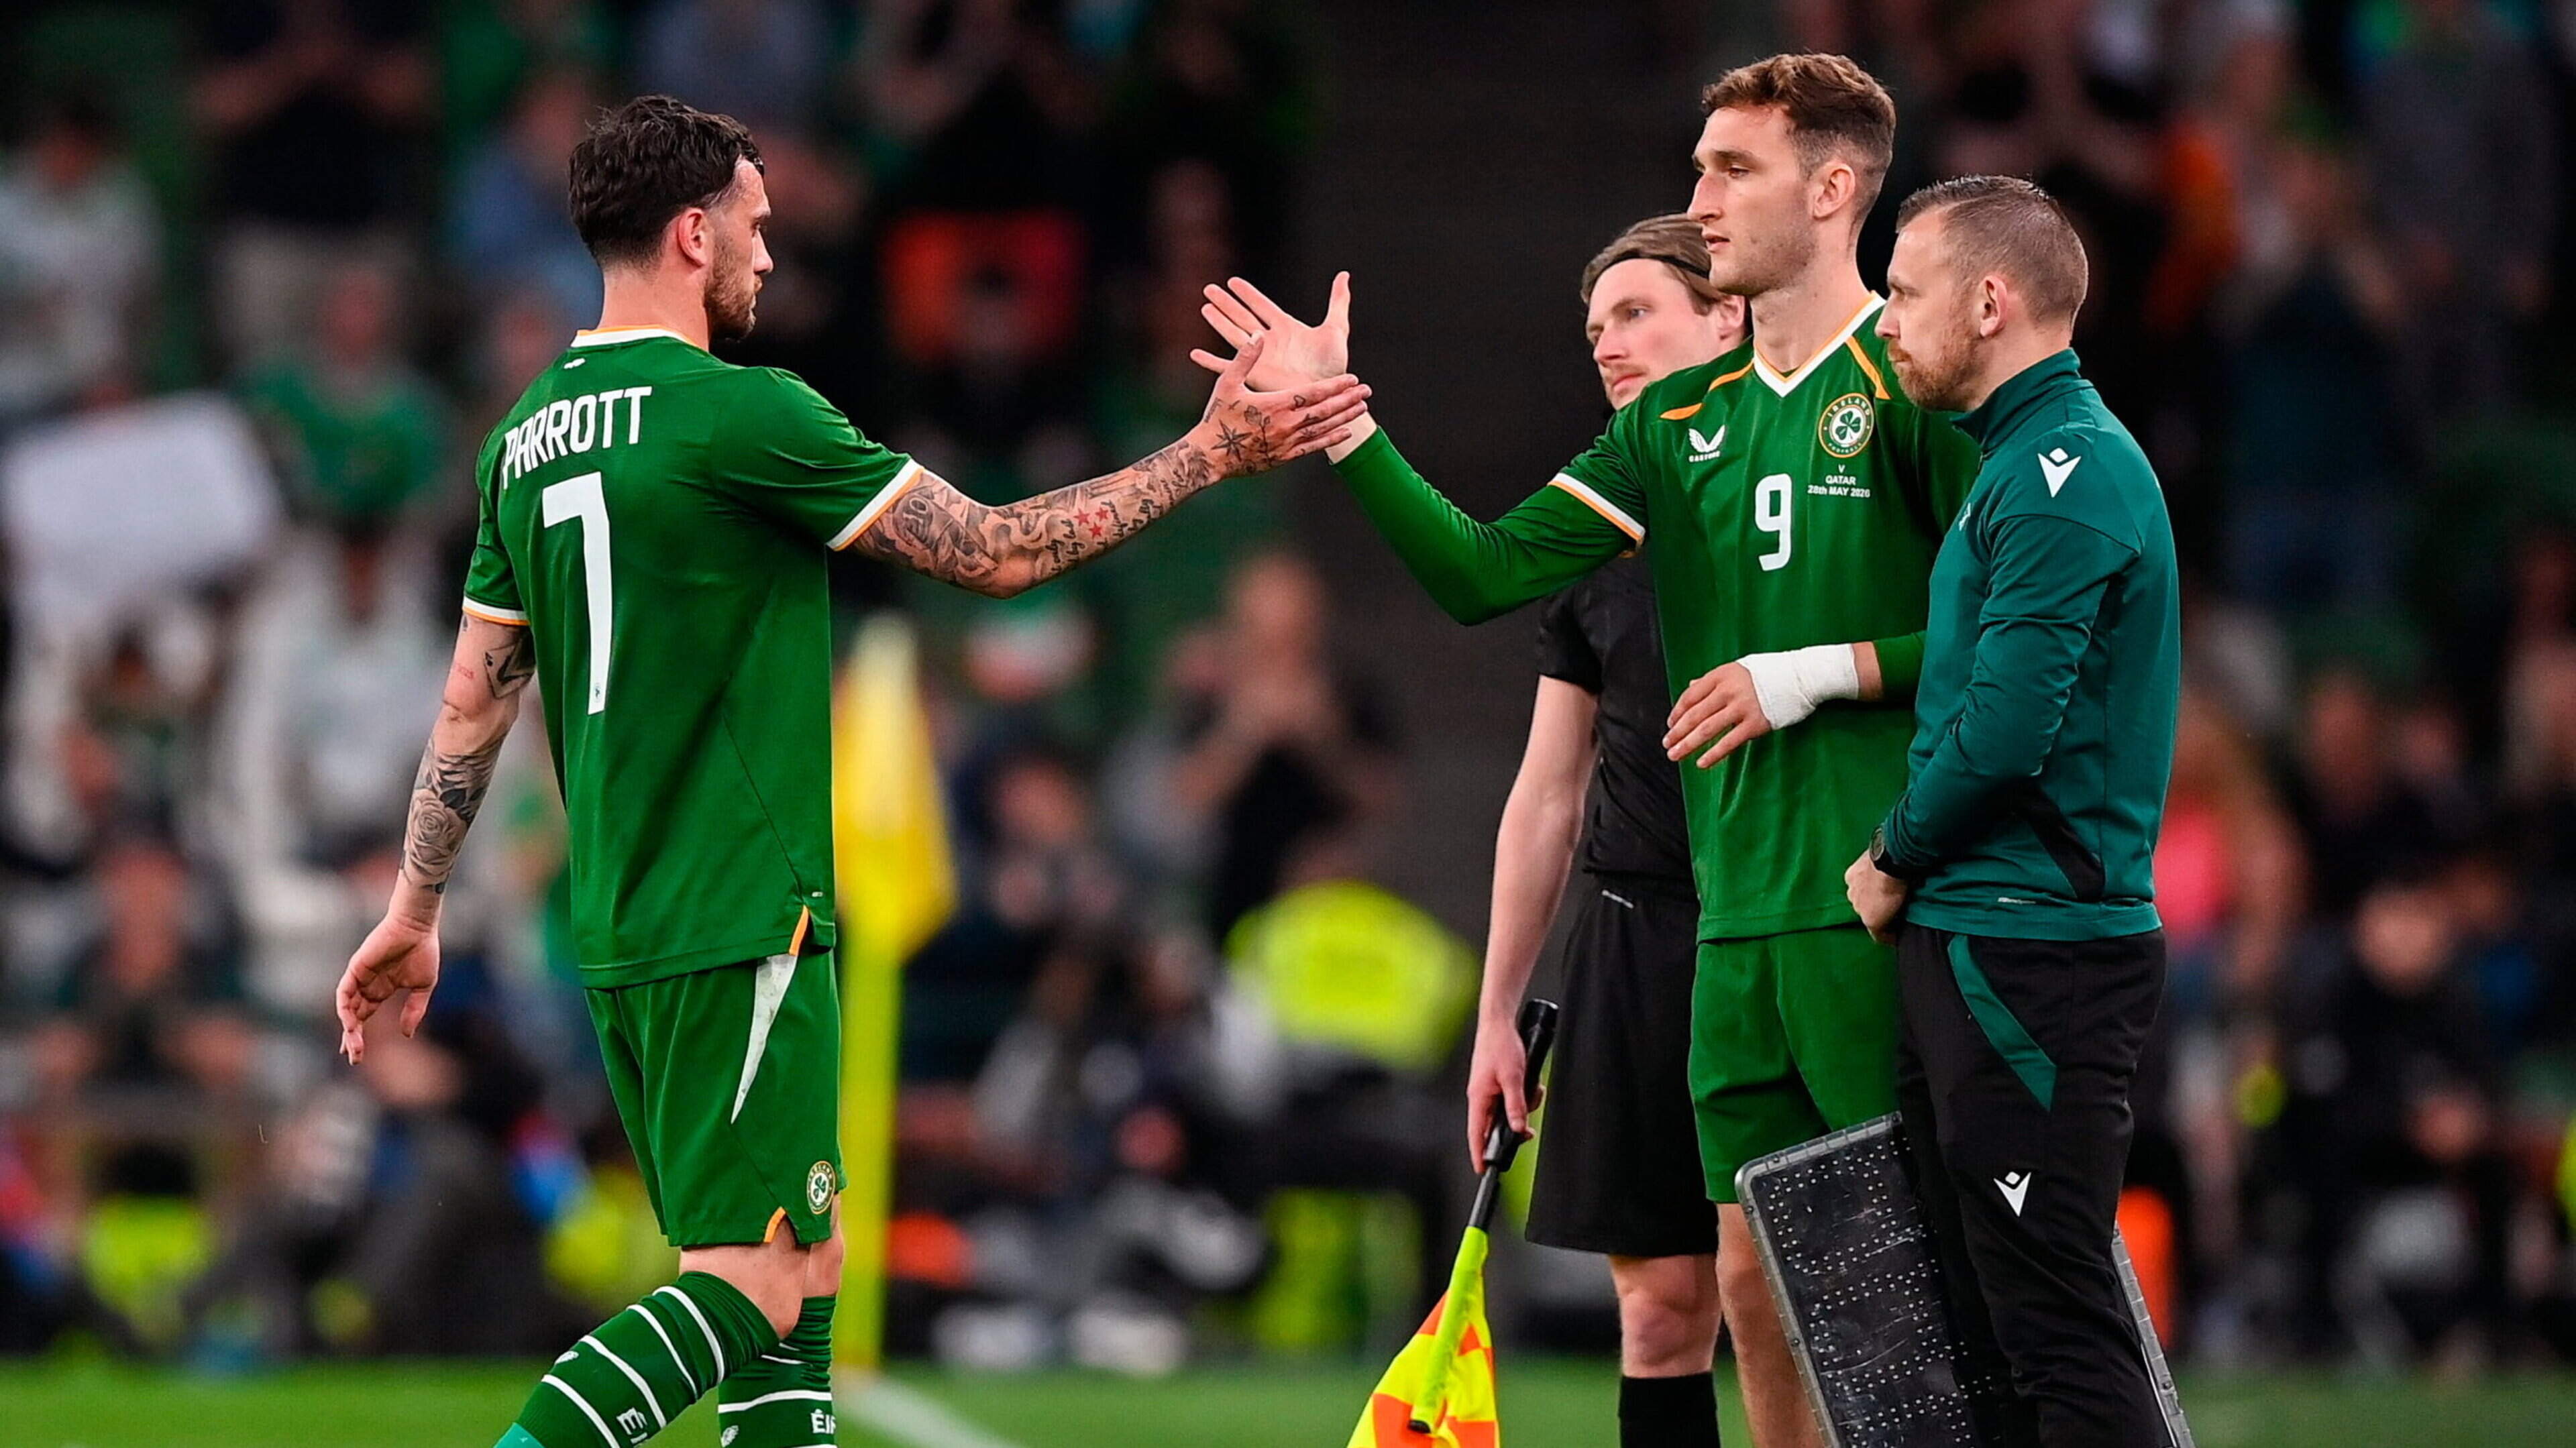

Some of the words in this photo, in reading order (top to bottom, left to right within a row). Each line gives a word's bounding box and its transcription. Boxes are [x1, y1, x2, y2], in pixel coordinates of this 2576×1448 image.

[1827, 397, 1870, 417] IRELAND
[501, 386, 653, 488] PARROTT
[1807, 484, 1827, 495] 28th
[1829, 486, 1849, 496] MAY
[1850, 488, 1870, 498] 2026
[1825, 475, 1856, 486] QATAR
[1755, 474, 1792, 571] 9
[541, 471, 612, 716] 7
